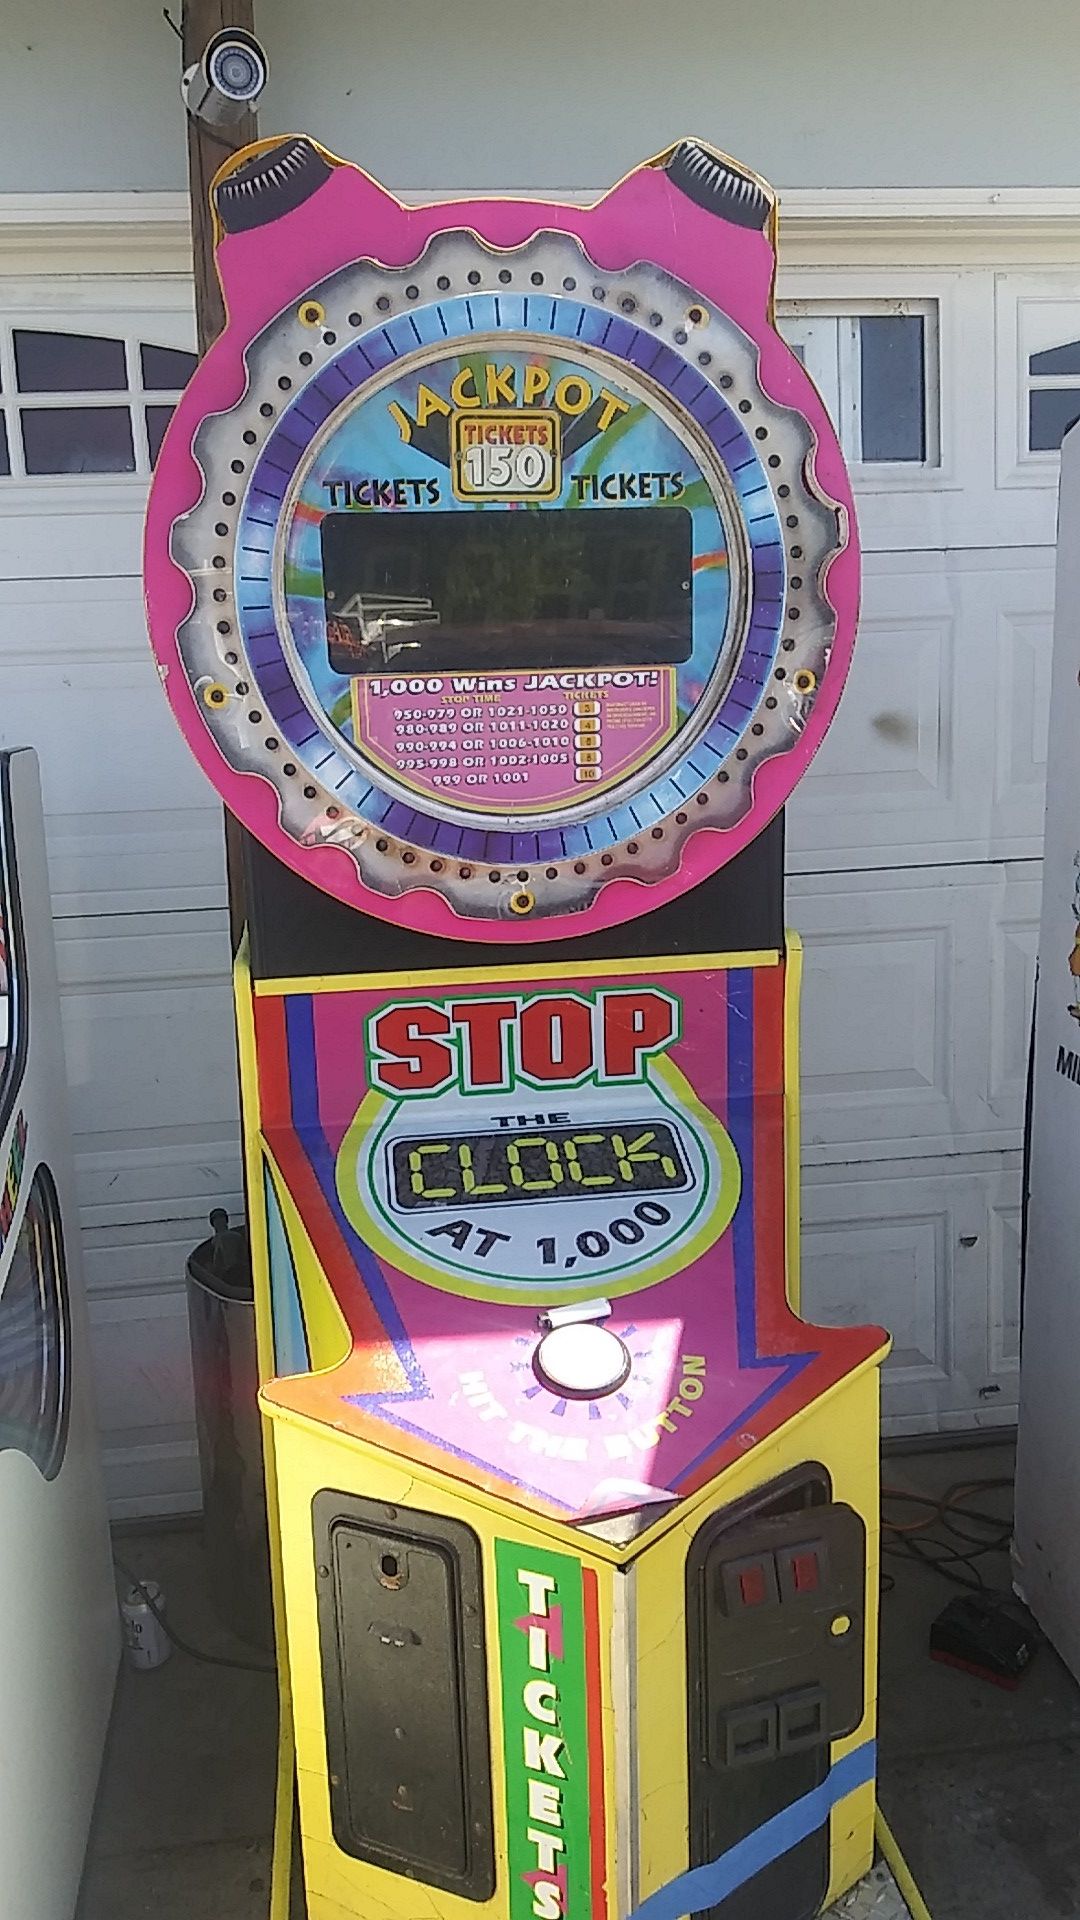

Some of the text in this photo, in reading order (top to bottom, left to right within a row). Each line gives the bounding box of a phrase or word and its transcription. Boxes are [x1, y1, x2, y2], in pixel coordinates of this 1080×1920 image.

[387, 363, 630, 443] JACKPOT
[463, 424, 548, 446] TICKETS
[464, 446, 546, 488] 150
[323, 477, 440, 507] TICKETS
[571, 472, 685, 502] TICKETS
[369, 671, 659, 698] 1,000 Wins JACKPOT!
[563, 690, 609, 701] TICKETS
[440, 693, 502, 705] STOP TIME
[393, 704, 568, 721] 950-979 OR 1021-1050
[395, 718, 570, 736] 980-989 OR 1011-1020
[395, 735, 571, 754] 990-994 OR 1006-1010
[396, 752, 570, 770] 995-998 OR 1002-1005
[432, 772, 530, 787] 999 OR 1001
[583, 769, 596, 779] 10
[370, 988, 678, 1094] STOP
[490, 1112, 571, 1127] THE
[408, 1132, 678, 1199] CLOCK
[425, 1201, 671, 1269] AT 1,000
[517, 1568, 569, 1920] TICKETS
